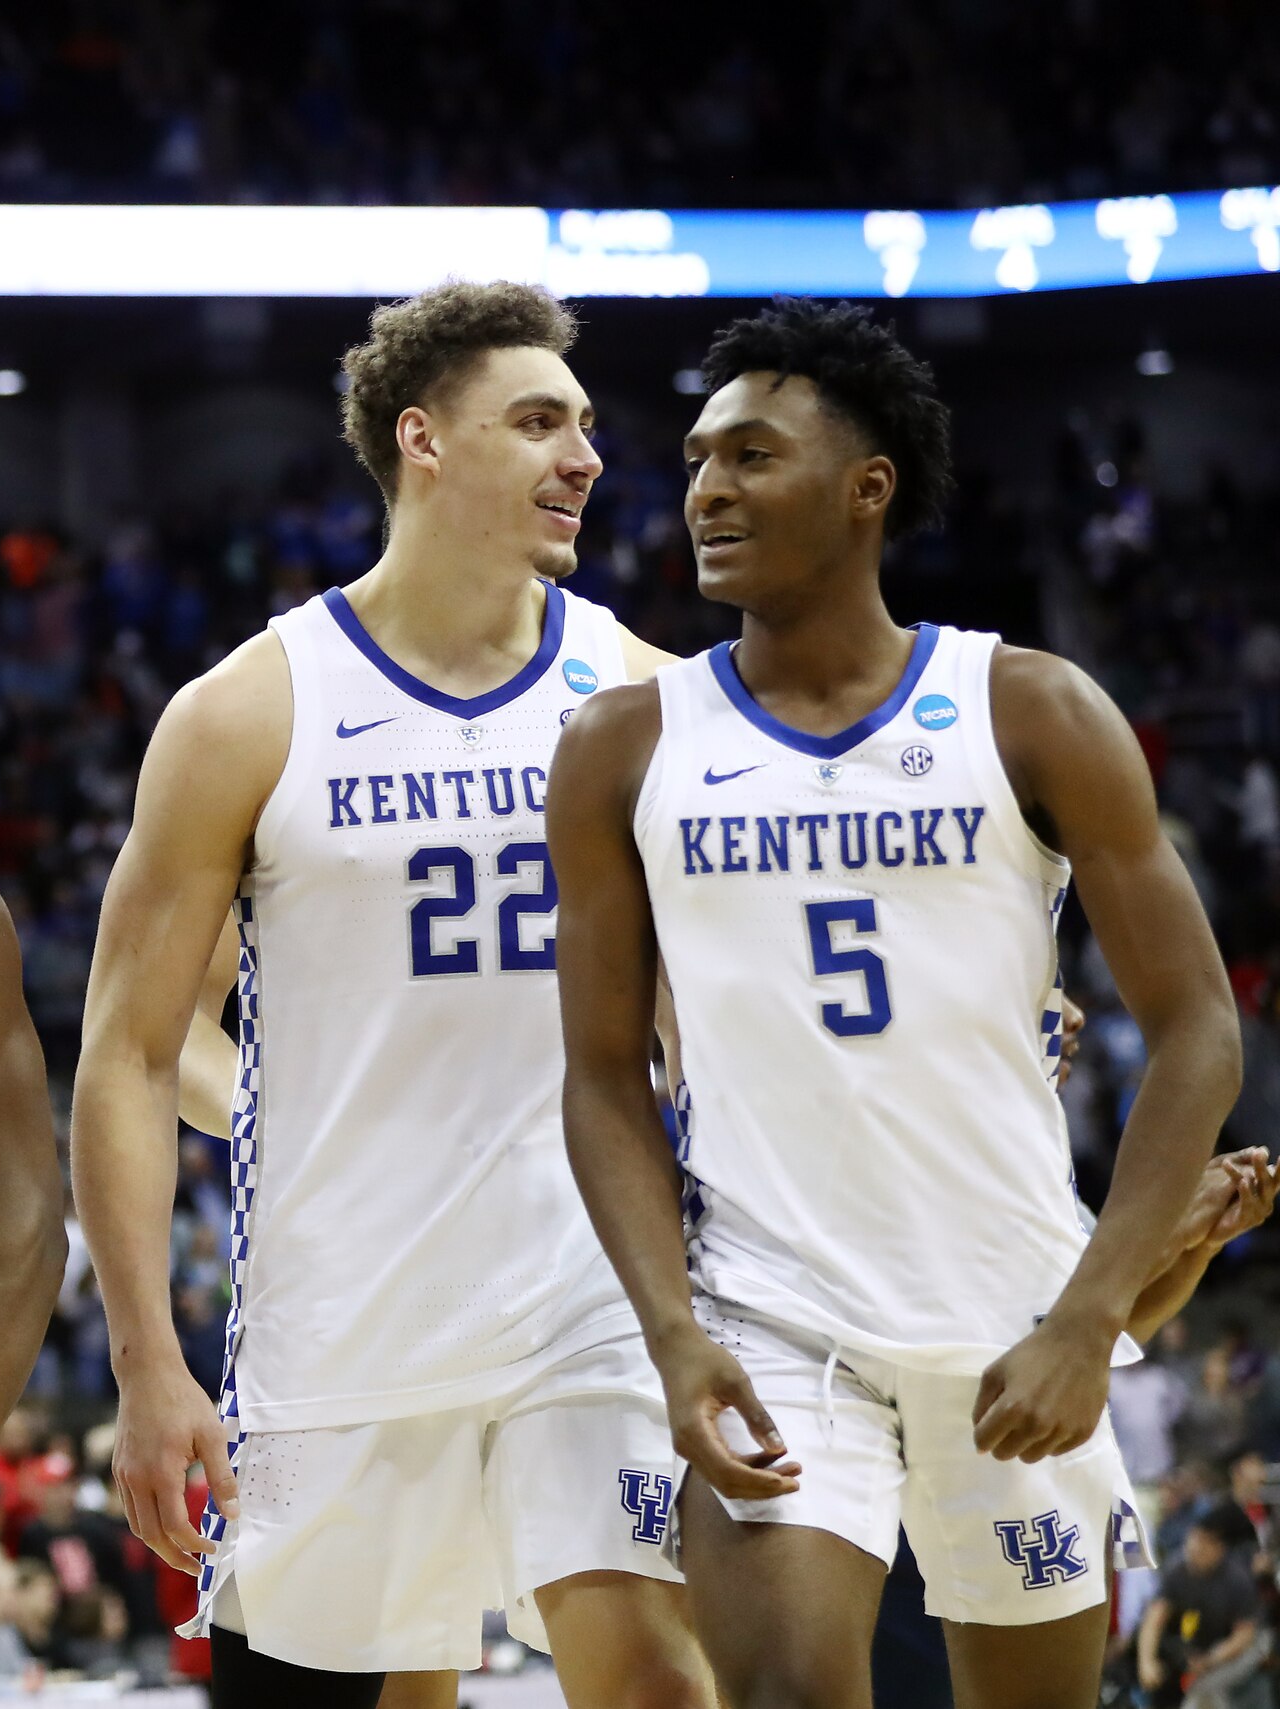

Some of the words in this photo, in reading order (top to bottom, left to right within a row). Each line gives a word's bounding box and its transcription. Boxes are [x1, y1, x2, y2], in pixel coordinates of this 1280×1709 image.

[919, 707, 956, 722] NCAA
[902, 746, 932, 775] SEC
[678, 807, 984, 874] KENTUCKY
[406, 843, 558, 978] 22
[804, 898, 892, 1037] 5
[993, 1508, 1088, 1590] UK
